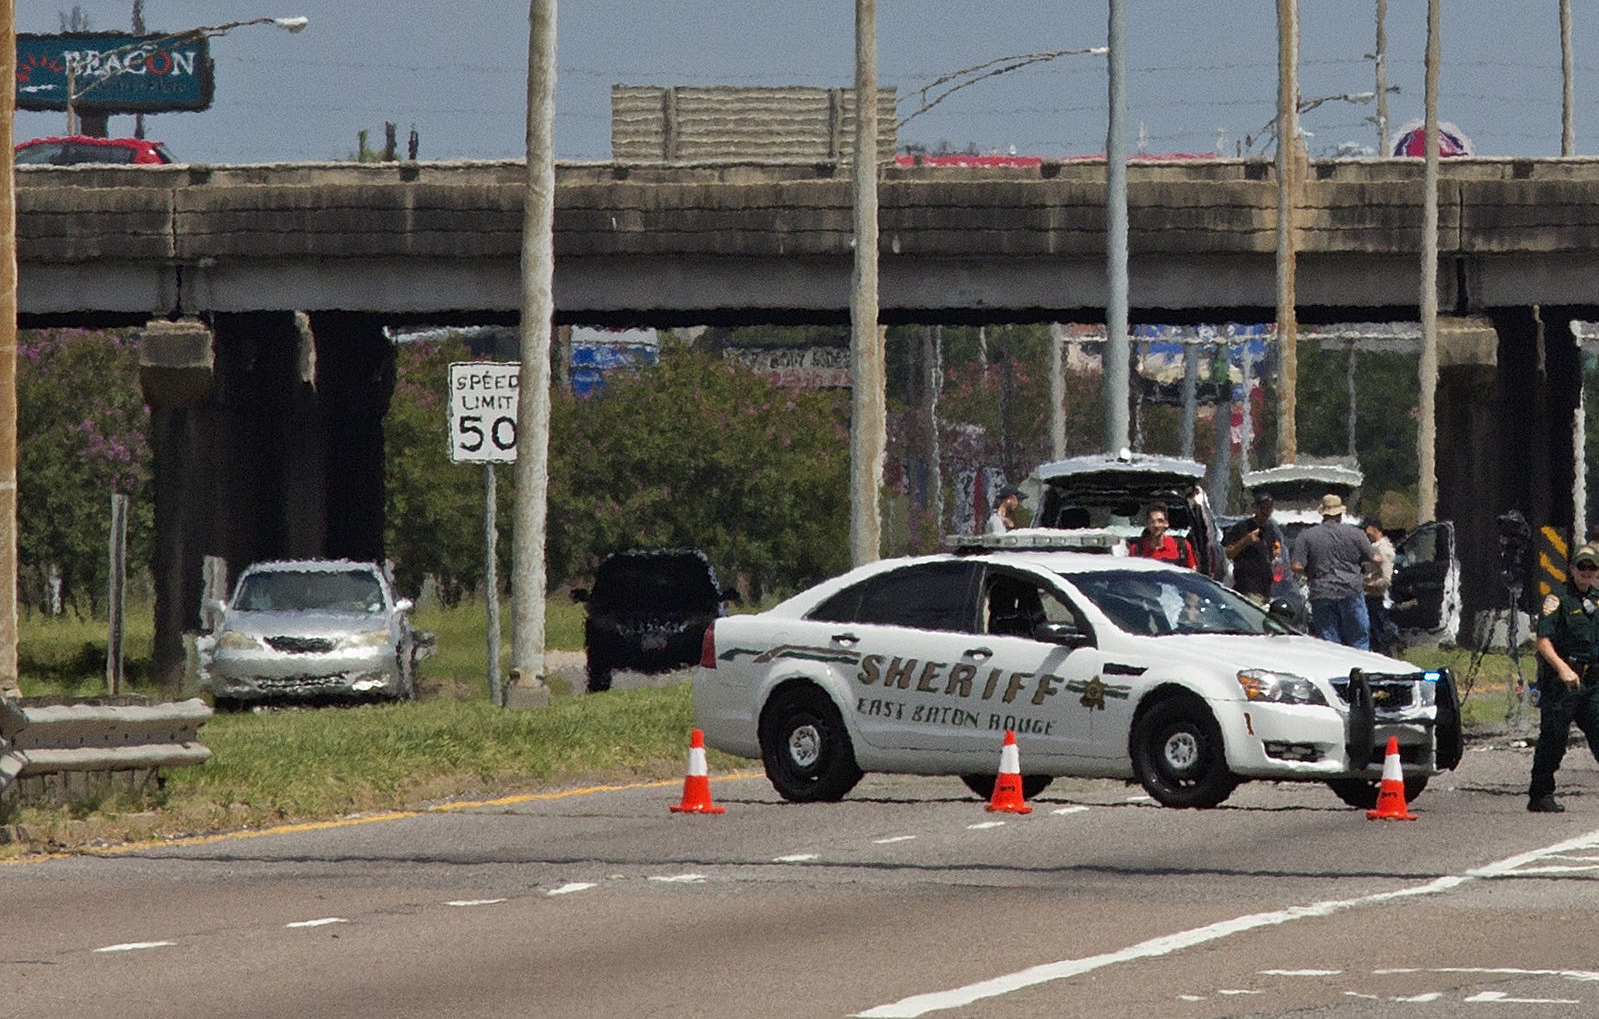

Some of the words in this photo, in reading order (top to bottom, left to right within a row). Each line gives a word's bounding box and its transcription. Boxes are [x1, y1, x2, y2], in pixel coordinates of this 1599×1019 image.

[64, 49, 196, 77] BEACON
[456, 374, 519, 391] SPEED
[462, 395, 514, 411] LIMIT
[459, 415, 517, 453] 50
[857, 654, 1065, 706] SHERIFF
[857, 698, 905, 720] EAST
[912, 704, 980, 729] BATON
[989, 714, 1059, 736] ROUGE
